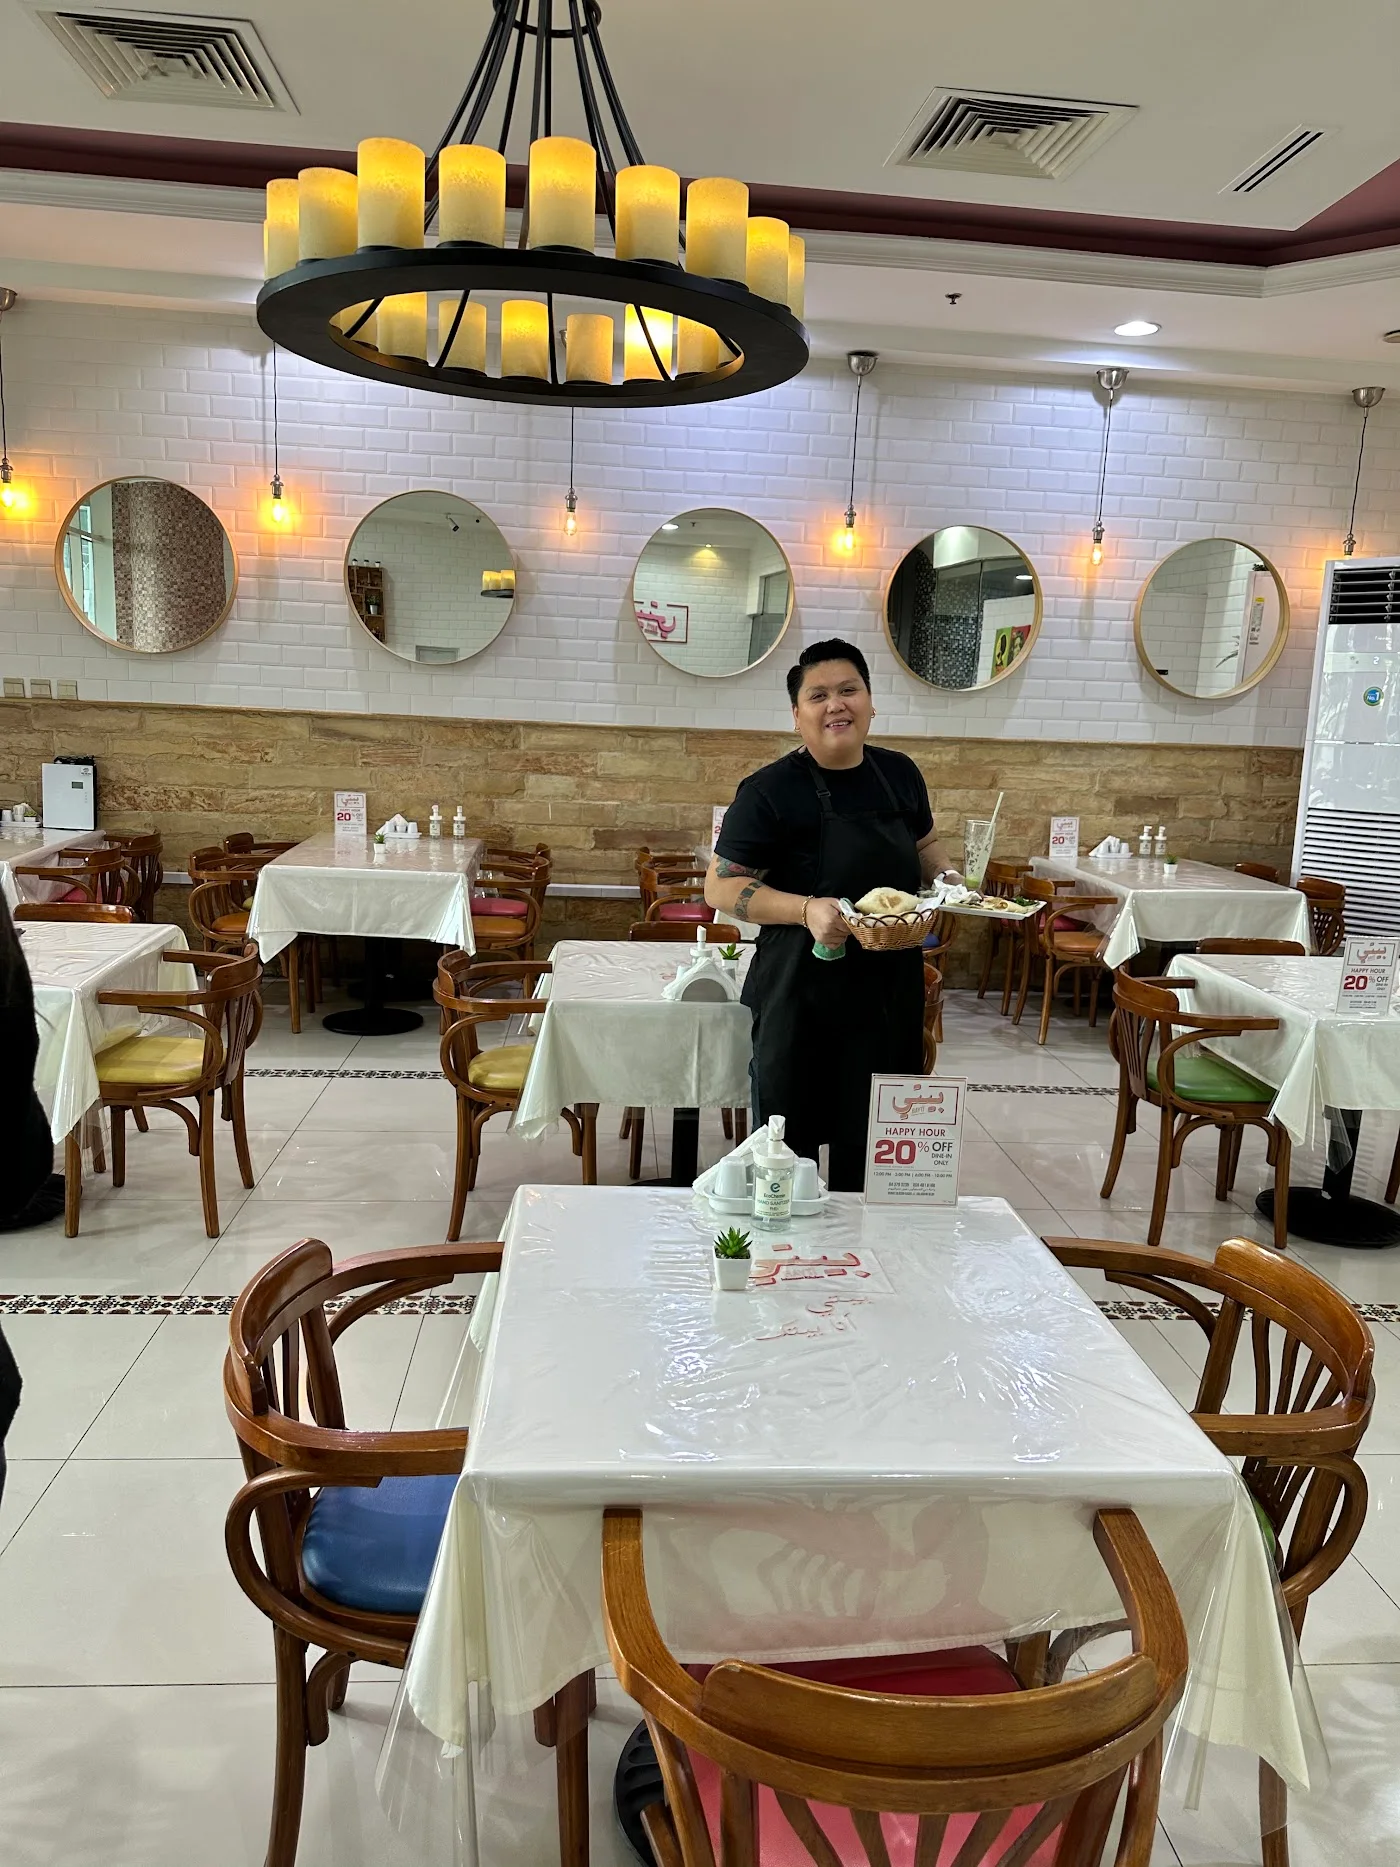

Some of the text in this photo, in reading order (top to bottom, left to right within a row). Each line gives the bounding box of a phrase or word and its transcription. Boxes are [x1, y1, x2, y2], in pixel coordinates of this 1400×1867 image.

[885, 1127, 946, 1137] HAPPY HOUR
[932, 1141, 953, 1152] OFF
